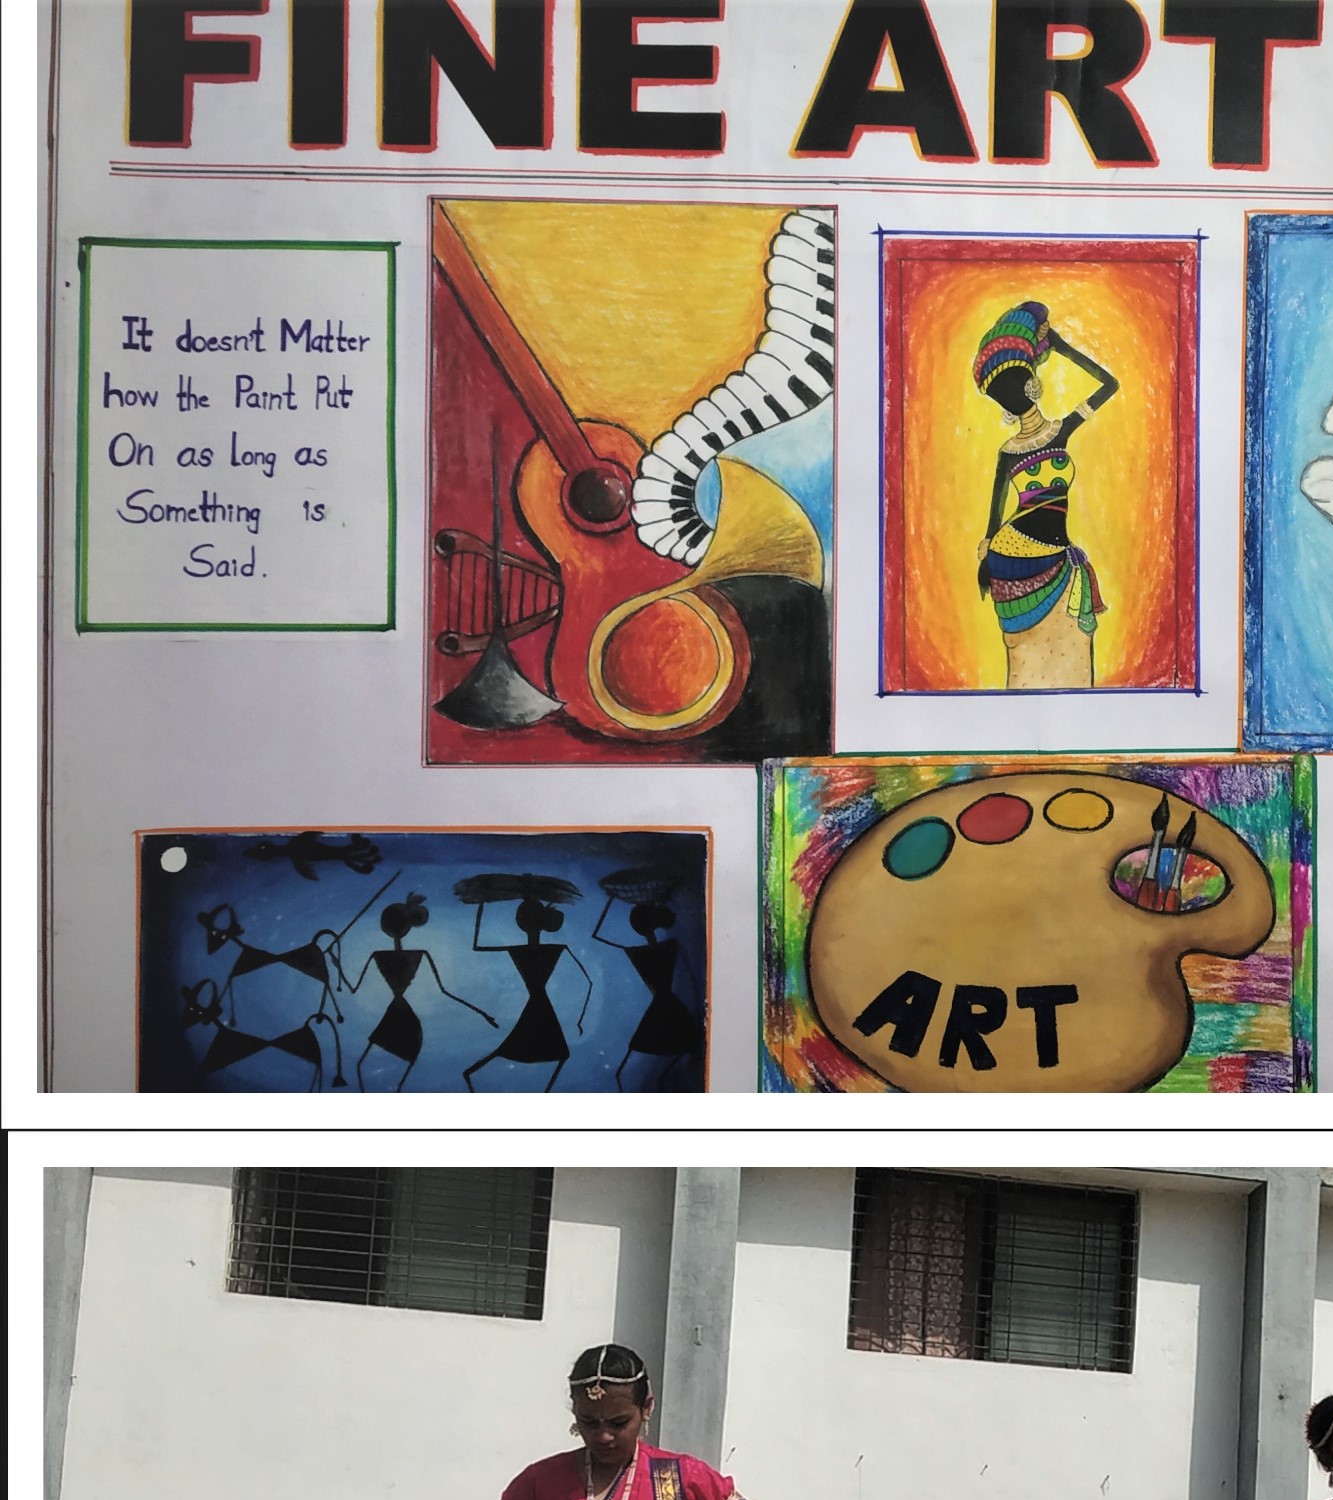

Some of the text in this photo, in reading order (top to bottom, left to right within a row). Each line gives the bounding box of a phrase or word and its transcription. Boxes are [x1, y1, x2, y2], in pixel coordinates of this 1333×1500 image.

[125, 0, 726, 158] FINE
[788, 0, 1324, 172] ART
[122, 316, 370, 353] It doesn't Matter
[104, 372, 353, 412] how the Paint Put
[109, 433, 153, 467] On
[177, 447, 214, 467] as
[295, 448, 327, 466] as
[117, 489, 324, 534] Something is
[183, 544, 266, 577] Said.
[852, 971, 1078, 1070] ART
